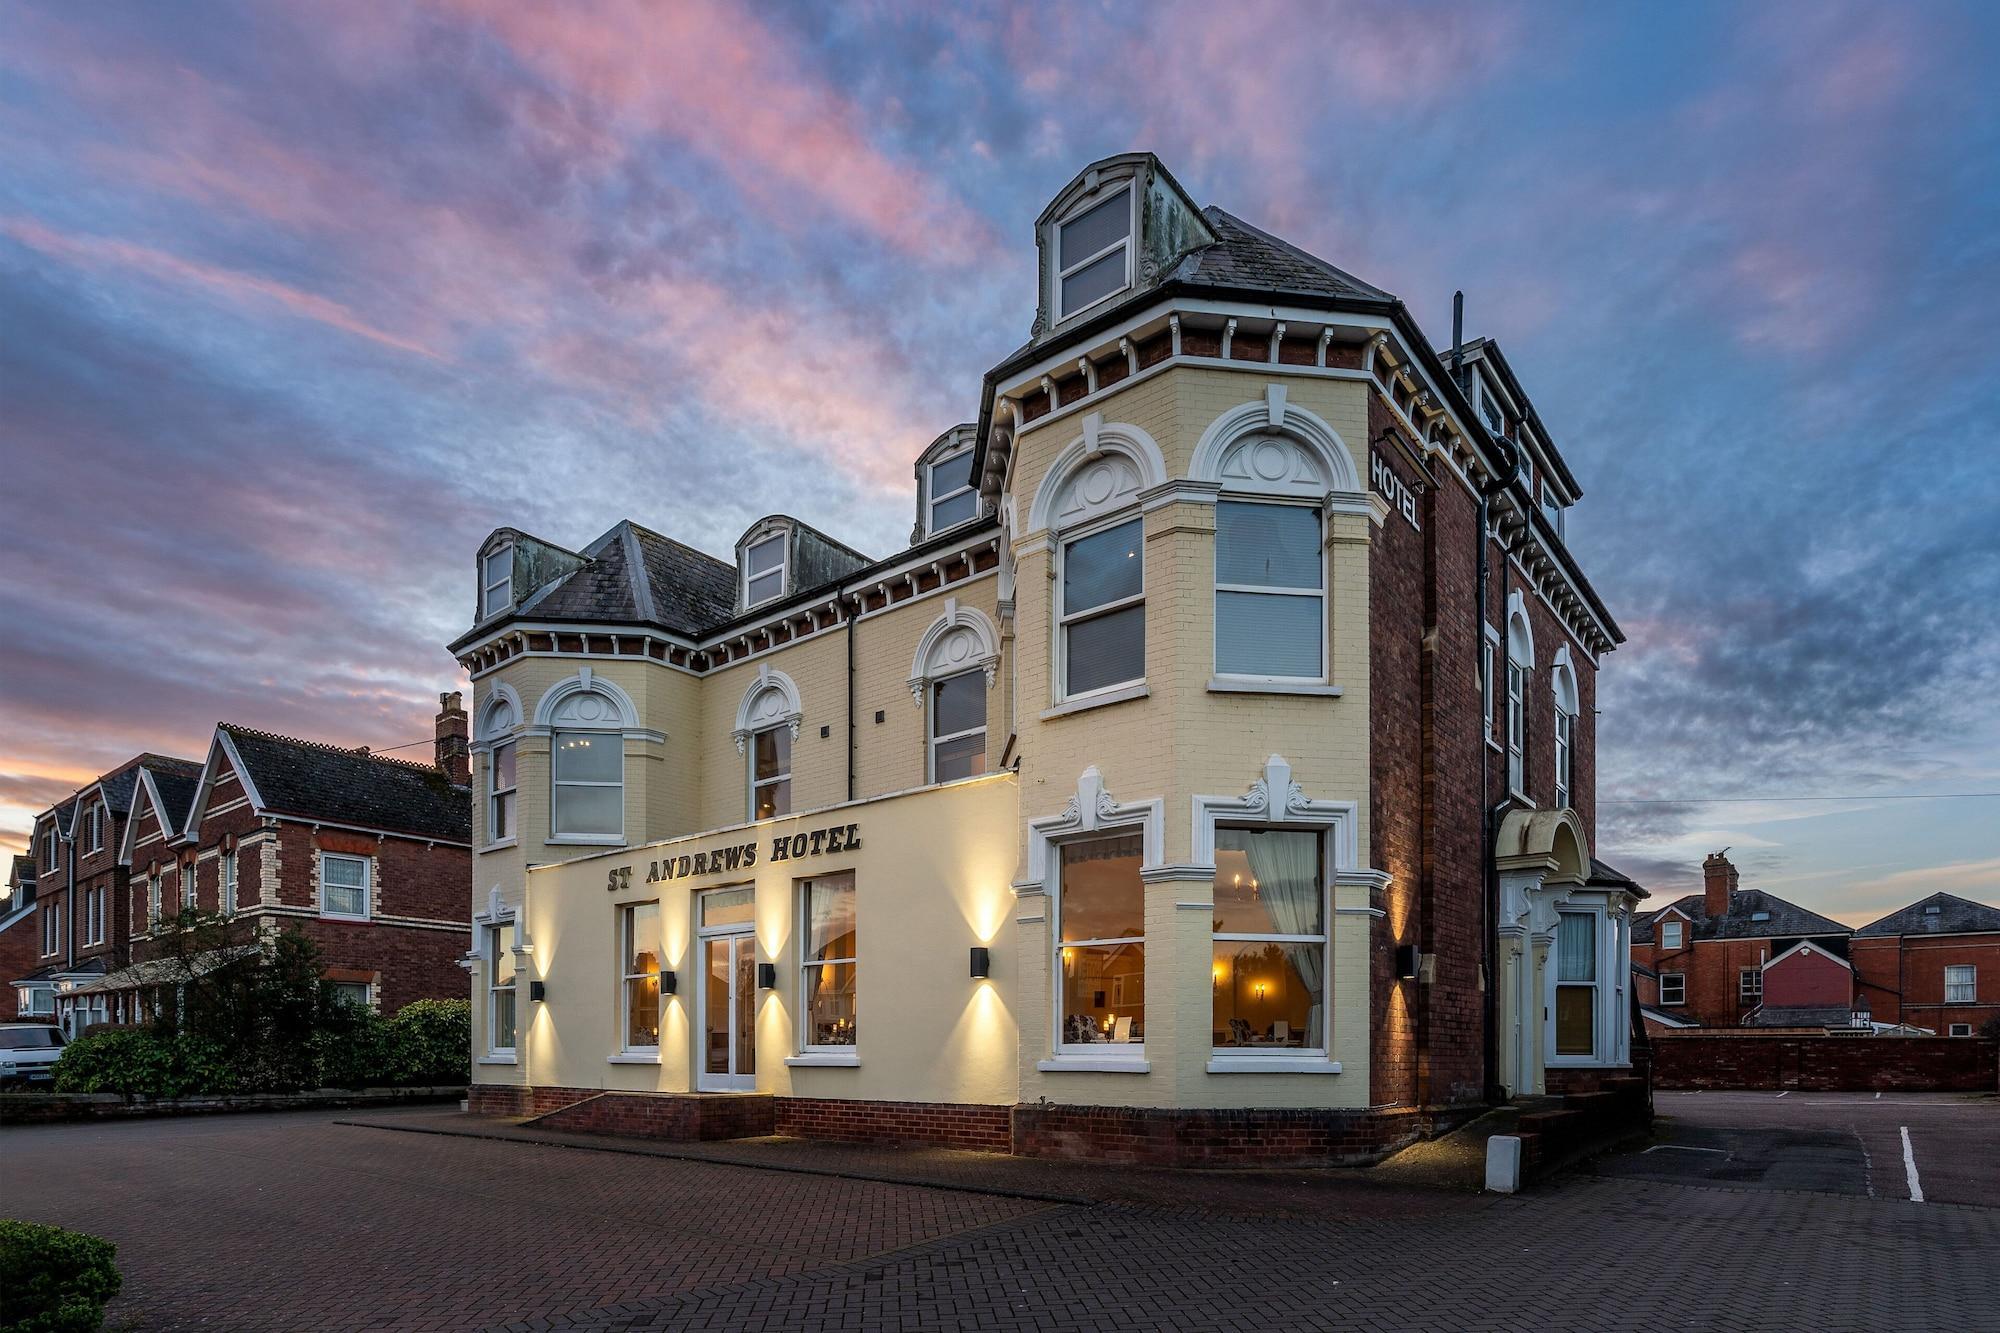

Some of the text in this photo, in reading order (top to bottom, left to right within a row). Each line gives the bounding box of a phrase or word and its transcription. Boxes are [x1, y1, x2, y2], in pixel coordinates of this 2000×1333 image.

[1372, 450, 1420, 532] HOTEL
[607, 823, 862, 891] ST ANDREWS HOTEL
